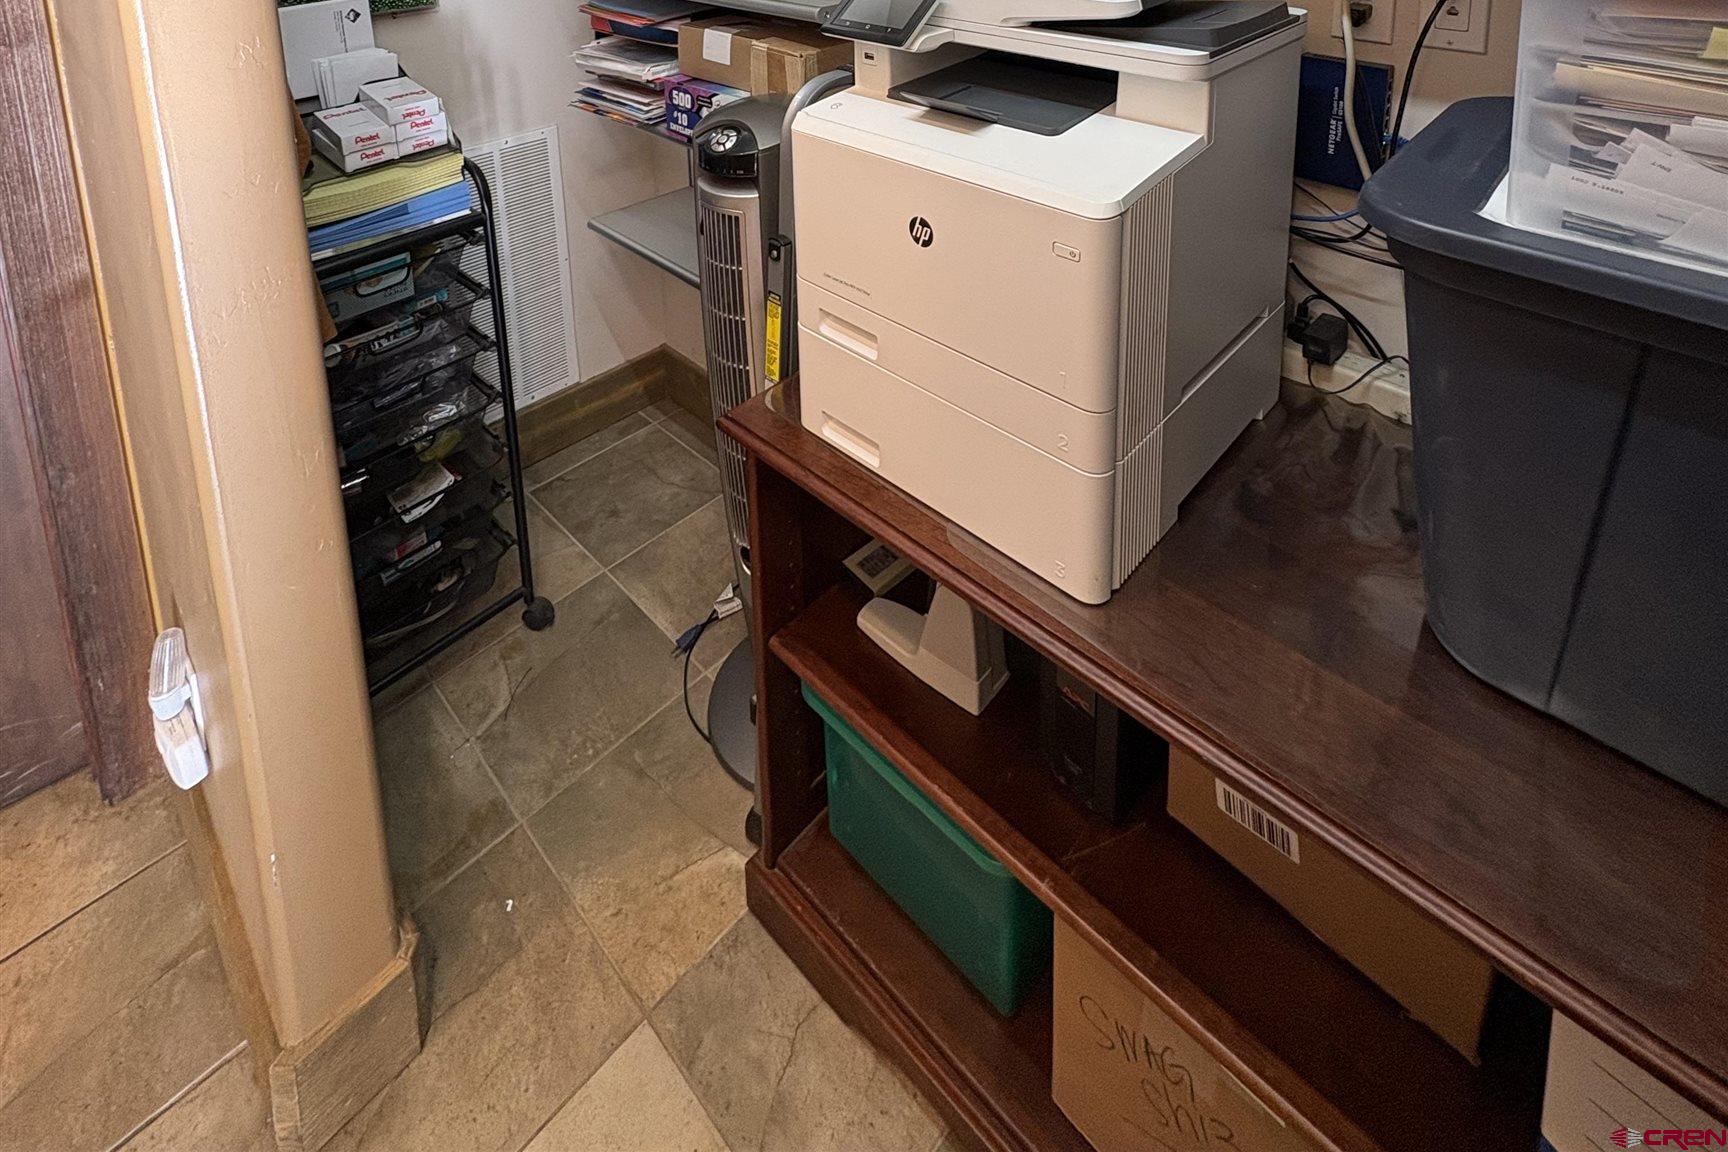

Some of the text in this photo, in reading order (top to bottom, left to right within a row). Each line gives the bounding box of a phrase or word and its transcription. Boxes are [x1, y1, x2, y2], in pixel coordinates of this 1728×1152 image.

[672, 89, 692, 109] 500
[402, 108, 426, 120] Pentel
[410, 118, 434, 129] Pentel
[354, 132, 380, 145] Pentel
[1327, 118, 1337, 155] NETGEAR
[412, 139, 435, 151] Pentel
[360, 148, 385, 161] Pentel
[911, 216, 932, 248] hp
[1057, 433, 1069, 453] 2
[1054, 559, 1066, 579] 3
